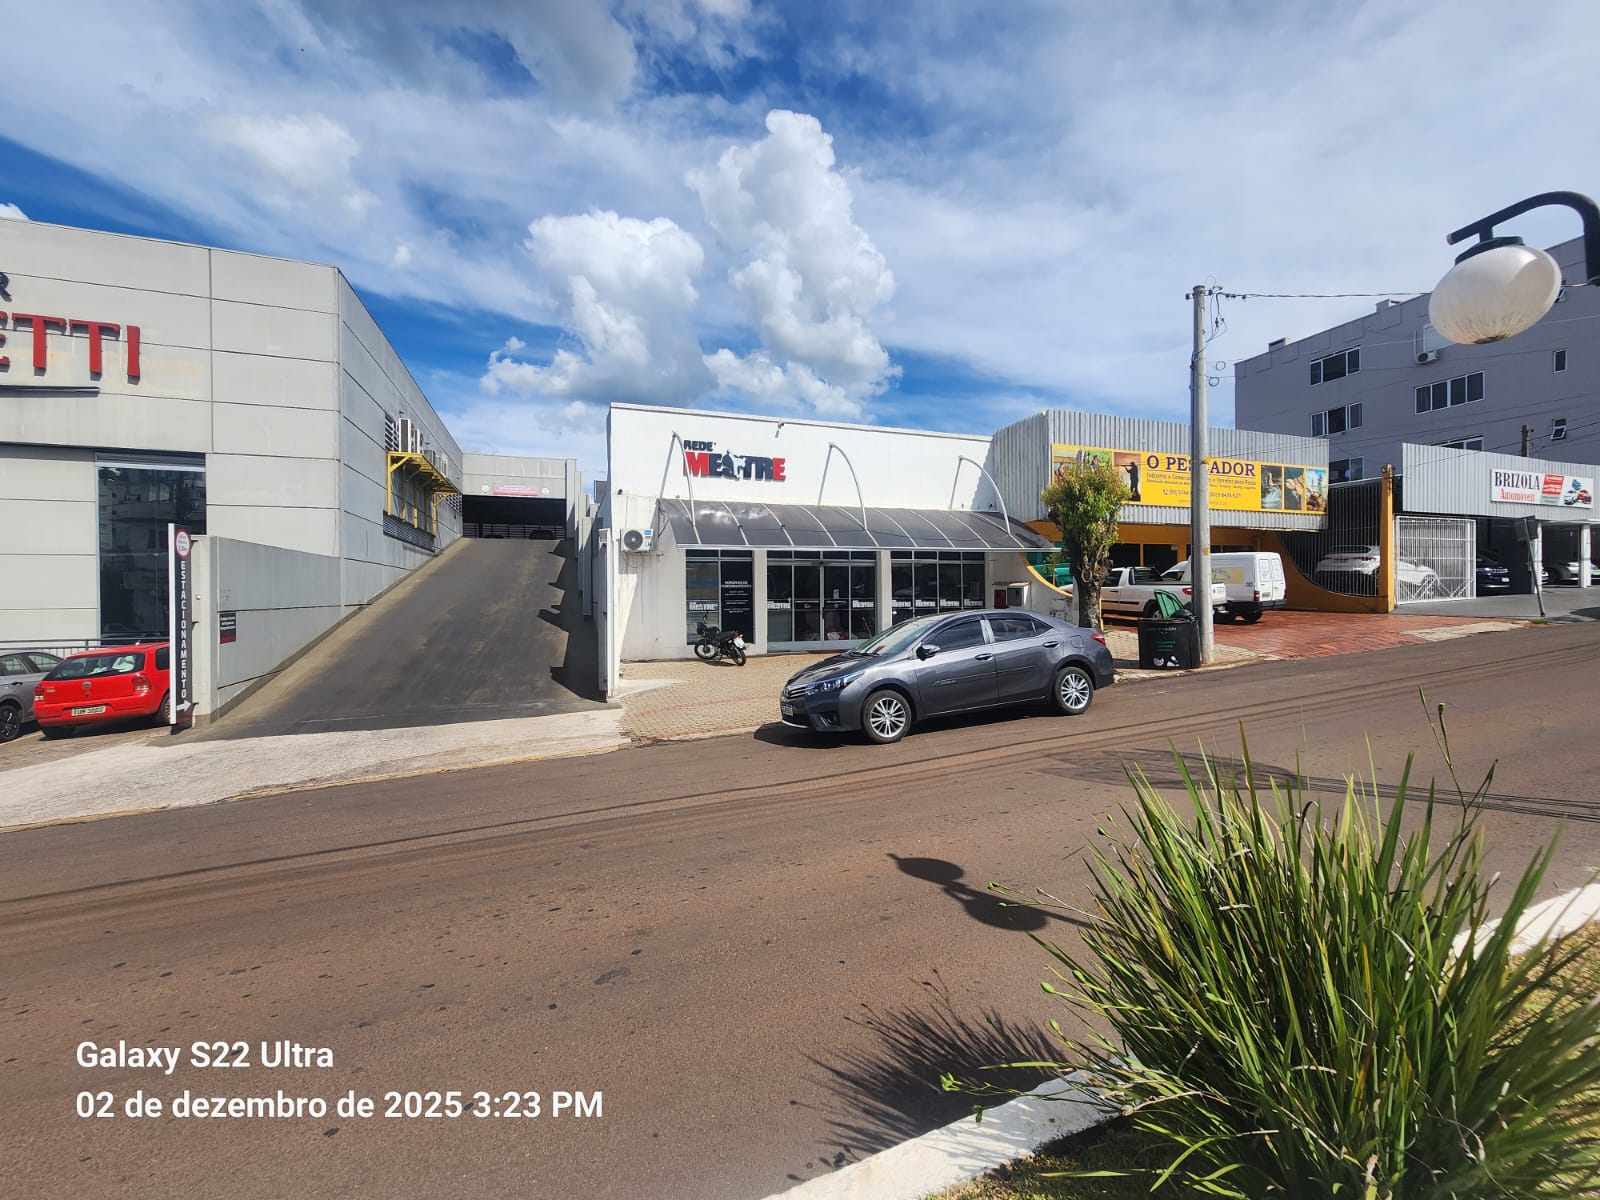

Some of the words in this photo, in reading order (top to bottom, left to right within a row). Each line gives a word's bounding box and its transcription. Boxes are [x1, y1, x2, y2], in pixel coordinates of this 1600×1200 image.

[0, 311, 141, 382] TTI
[683, 440, 713, 451] REDE
[1147, 455, 1159, 469] O
[1166, 457, 1256, 477] PEADOR
[1495, 472, 1540, 490] BRIZOLA
[180, 560, 188, 698] ESTACIONAMENTO
